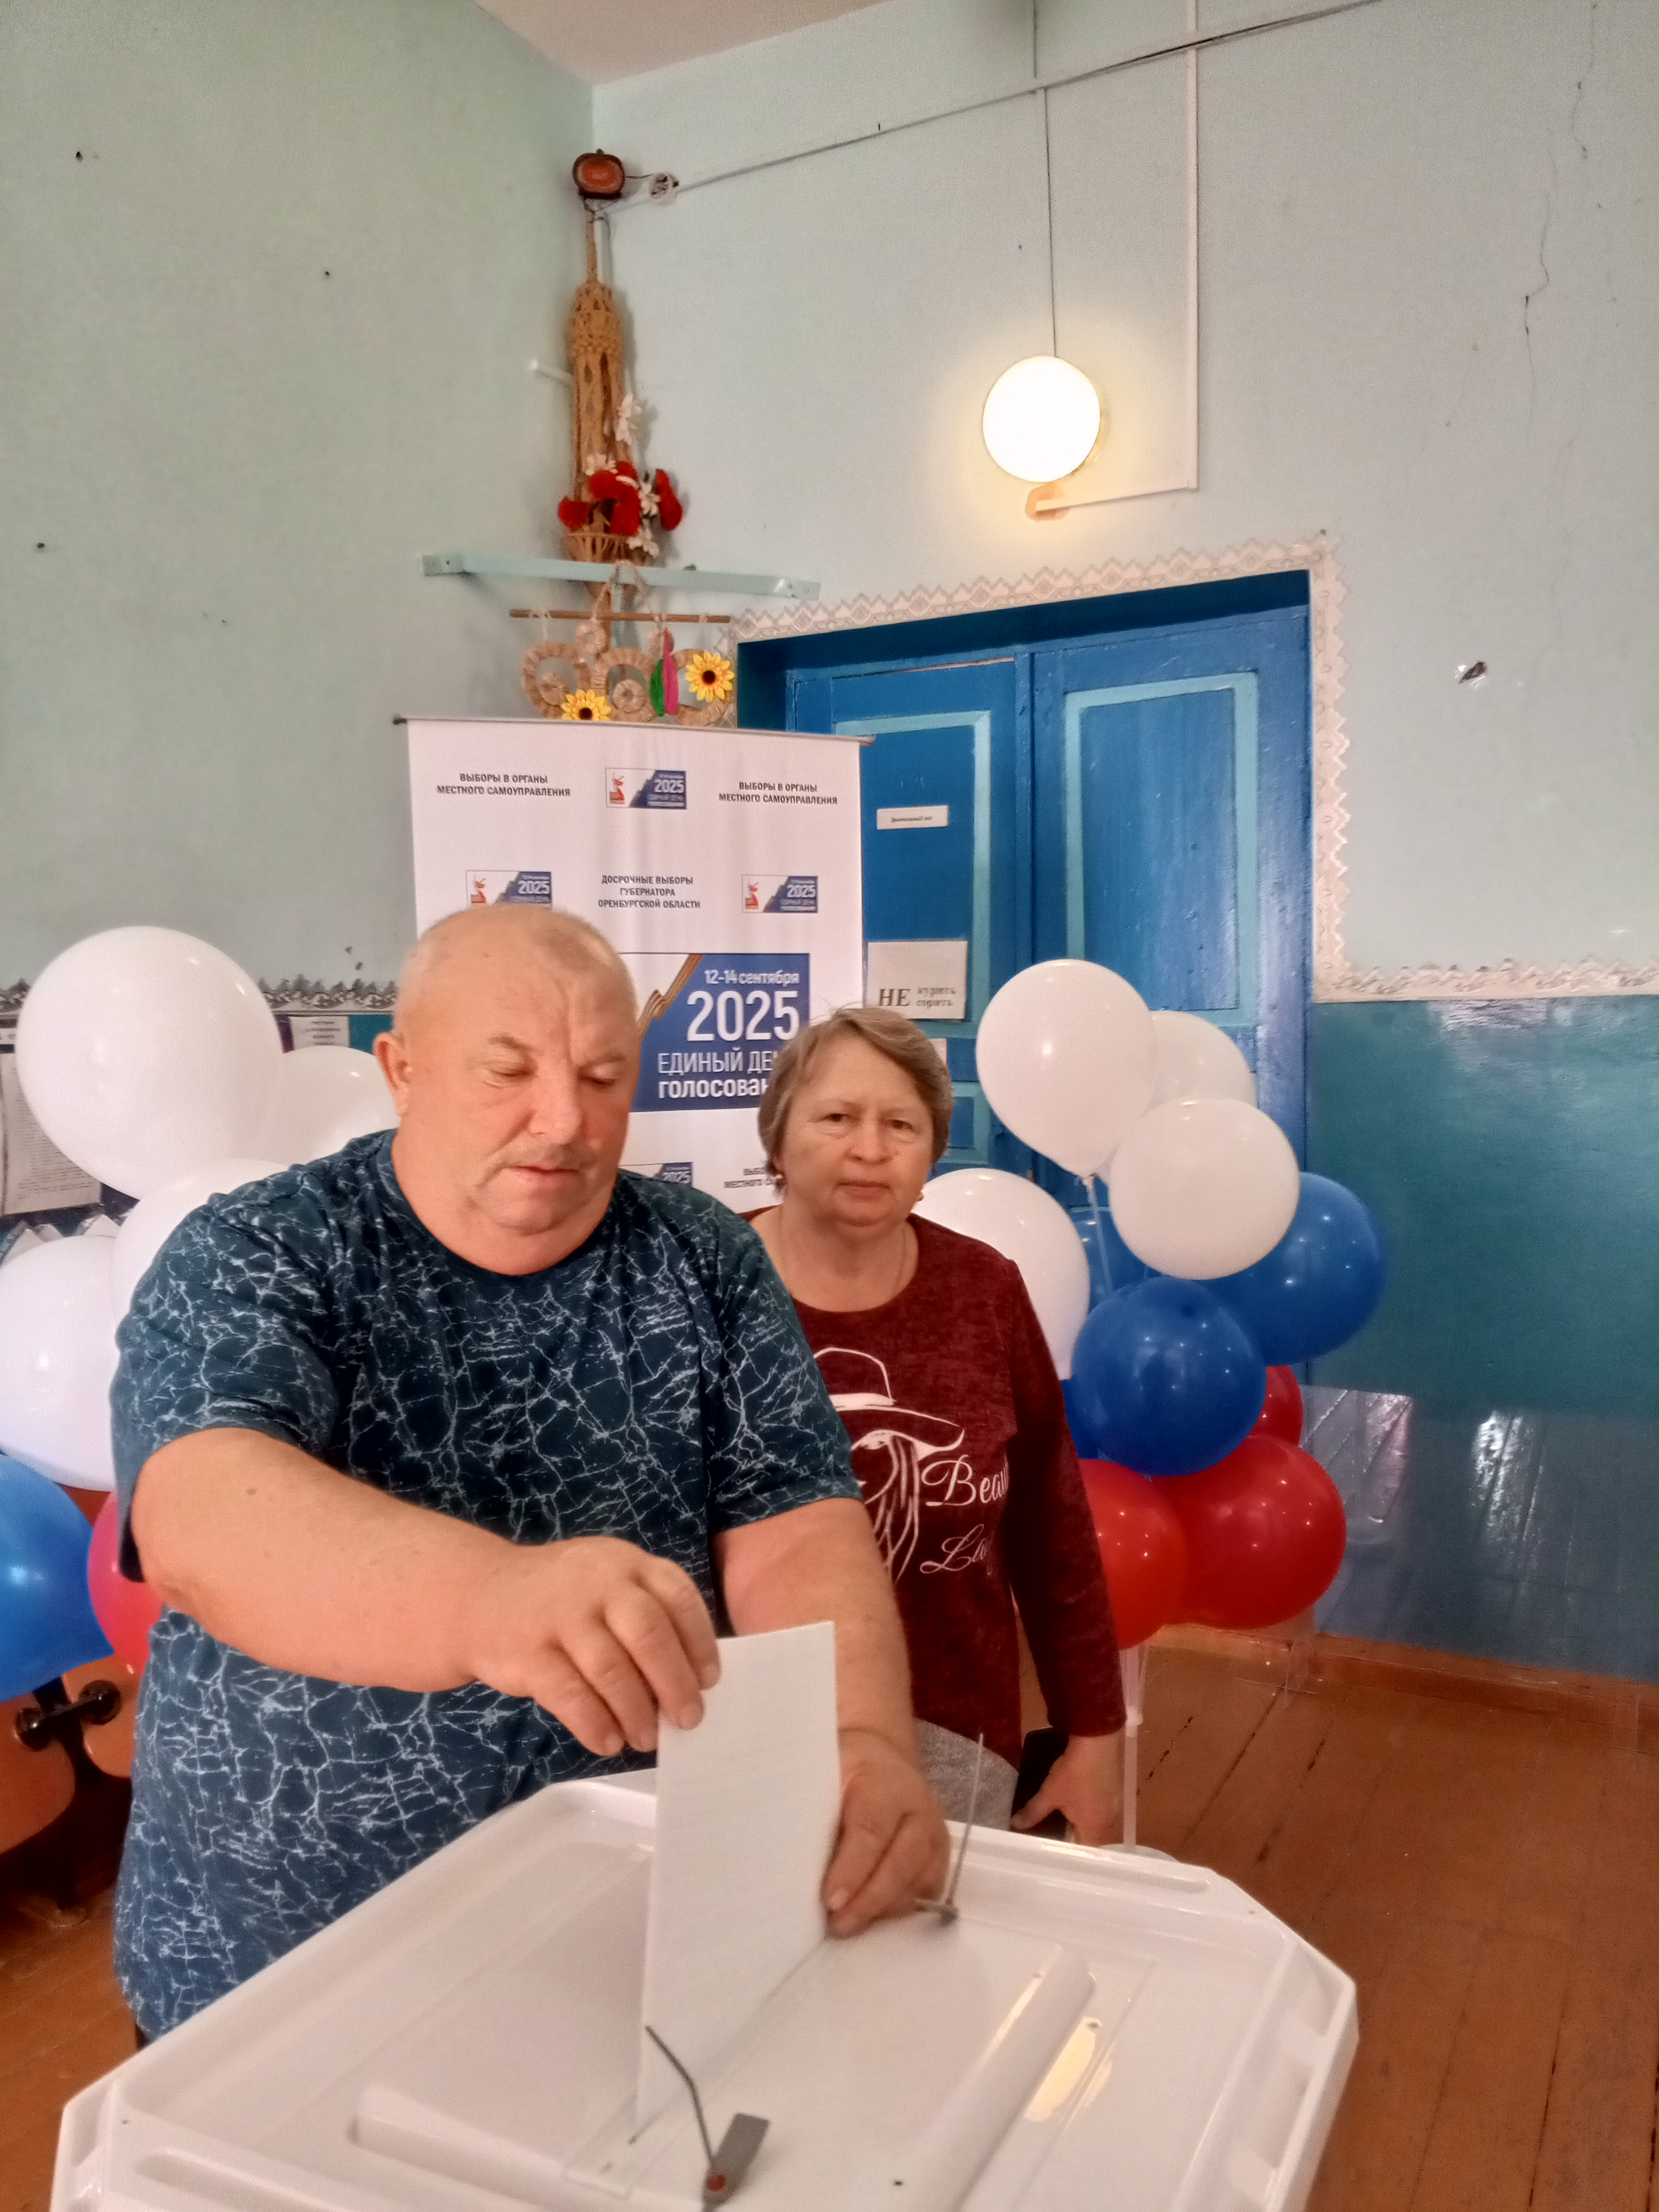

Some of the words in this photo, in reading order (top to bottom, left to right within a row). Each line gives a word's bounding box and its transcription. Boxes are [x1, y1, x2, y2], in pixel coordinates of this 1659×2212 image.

[459, 773, 501, 783] ВЫБОРЫ
[503, 775, 509, 783] В
[512, 775, 548, 784] ОРГАНЫ
[437, 785, 484, 795] МЕСТНОГО
[487, 787, 571, 797] САМОУПРАВЛЕНИЯ
[654, 779, 684, 793] 2025
[739, 782, 776, 791] ВЫБОРЫ
[778, 783, 783, 791] В
[785, 784, 817, 792] ОРГАНЫ
[718, 793, 760, 802] МЕСТНОГО
[763, 795, 838, 804] САМОУПРАВЛЕНИЯ
[601, 875, 653, 884] ДОСРОЧНЫЕ
[655, 876, 693, 884] ВЫБОРЫ
[518, 880, 550, 894] 2025
[620, 888, 675, 896] ГУБЕРНАТОРА
[787, 884, 816, 898] 2025
[598, 899, 661, 908] ОРЕНБУРГСКОЙ
[663, 900, 701, 908] ОБЛАСТИ
[704, 969, 738, 984] 12-14
[739, 970, 800, 987] сентября
[877, 988, 911, 1006] НЕ
[687, 990, 800, 1042] 2025
[658, 1046, 744, 1076] ЕДИНЫЙ
[747, 1050, 778, 1074] ДЕ
